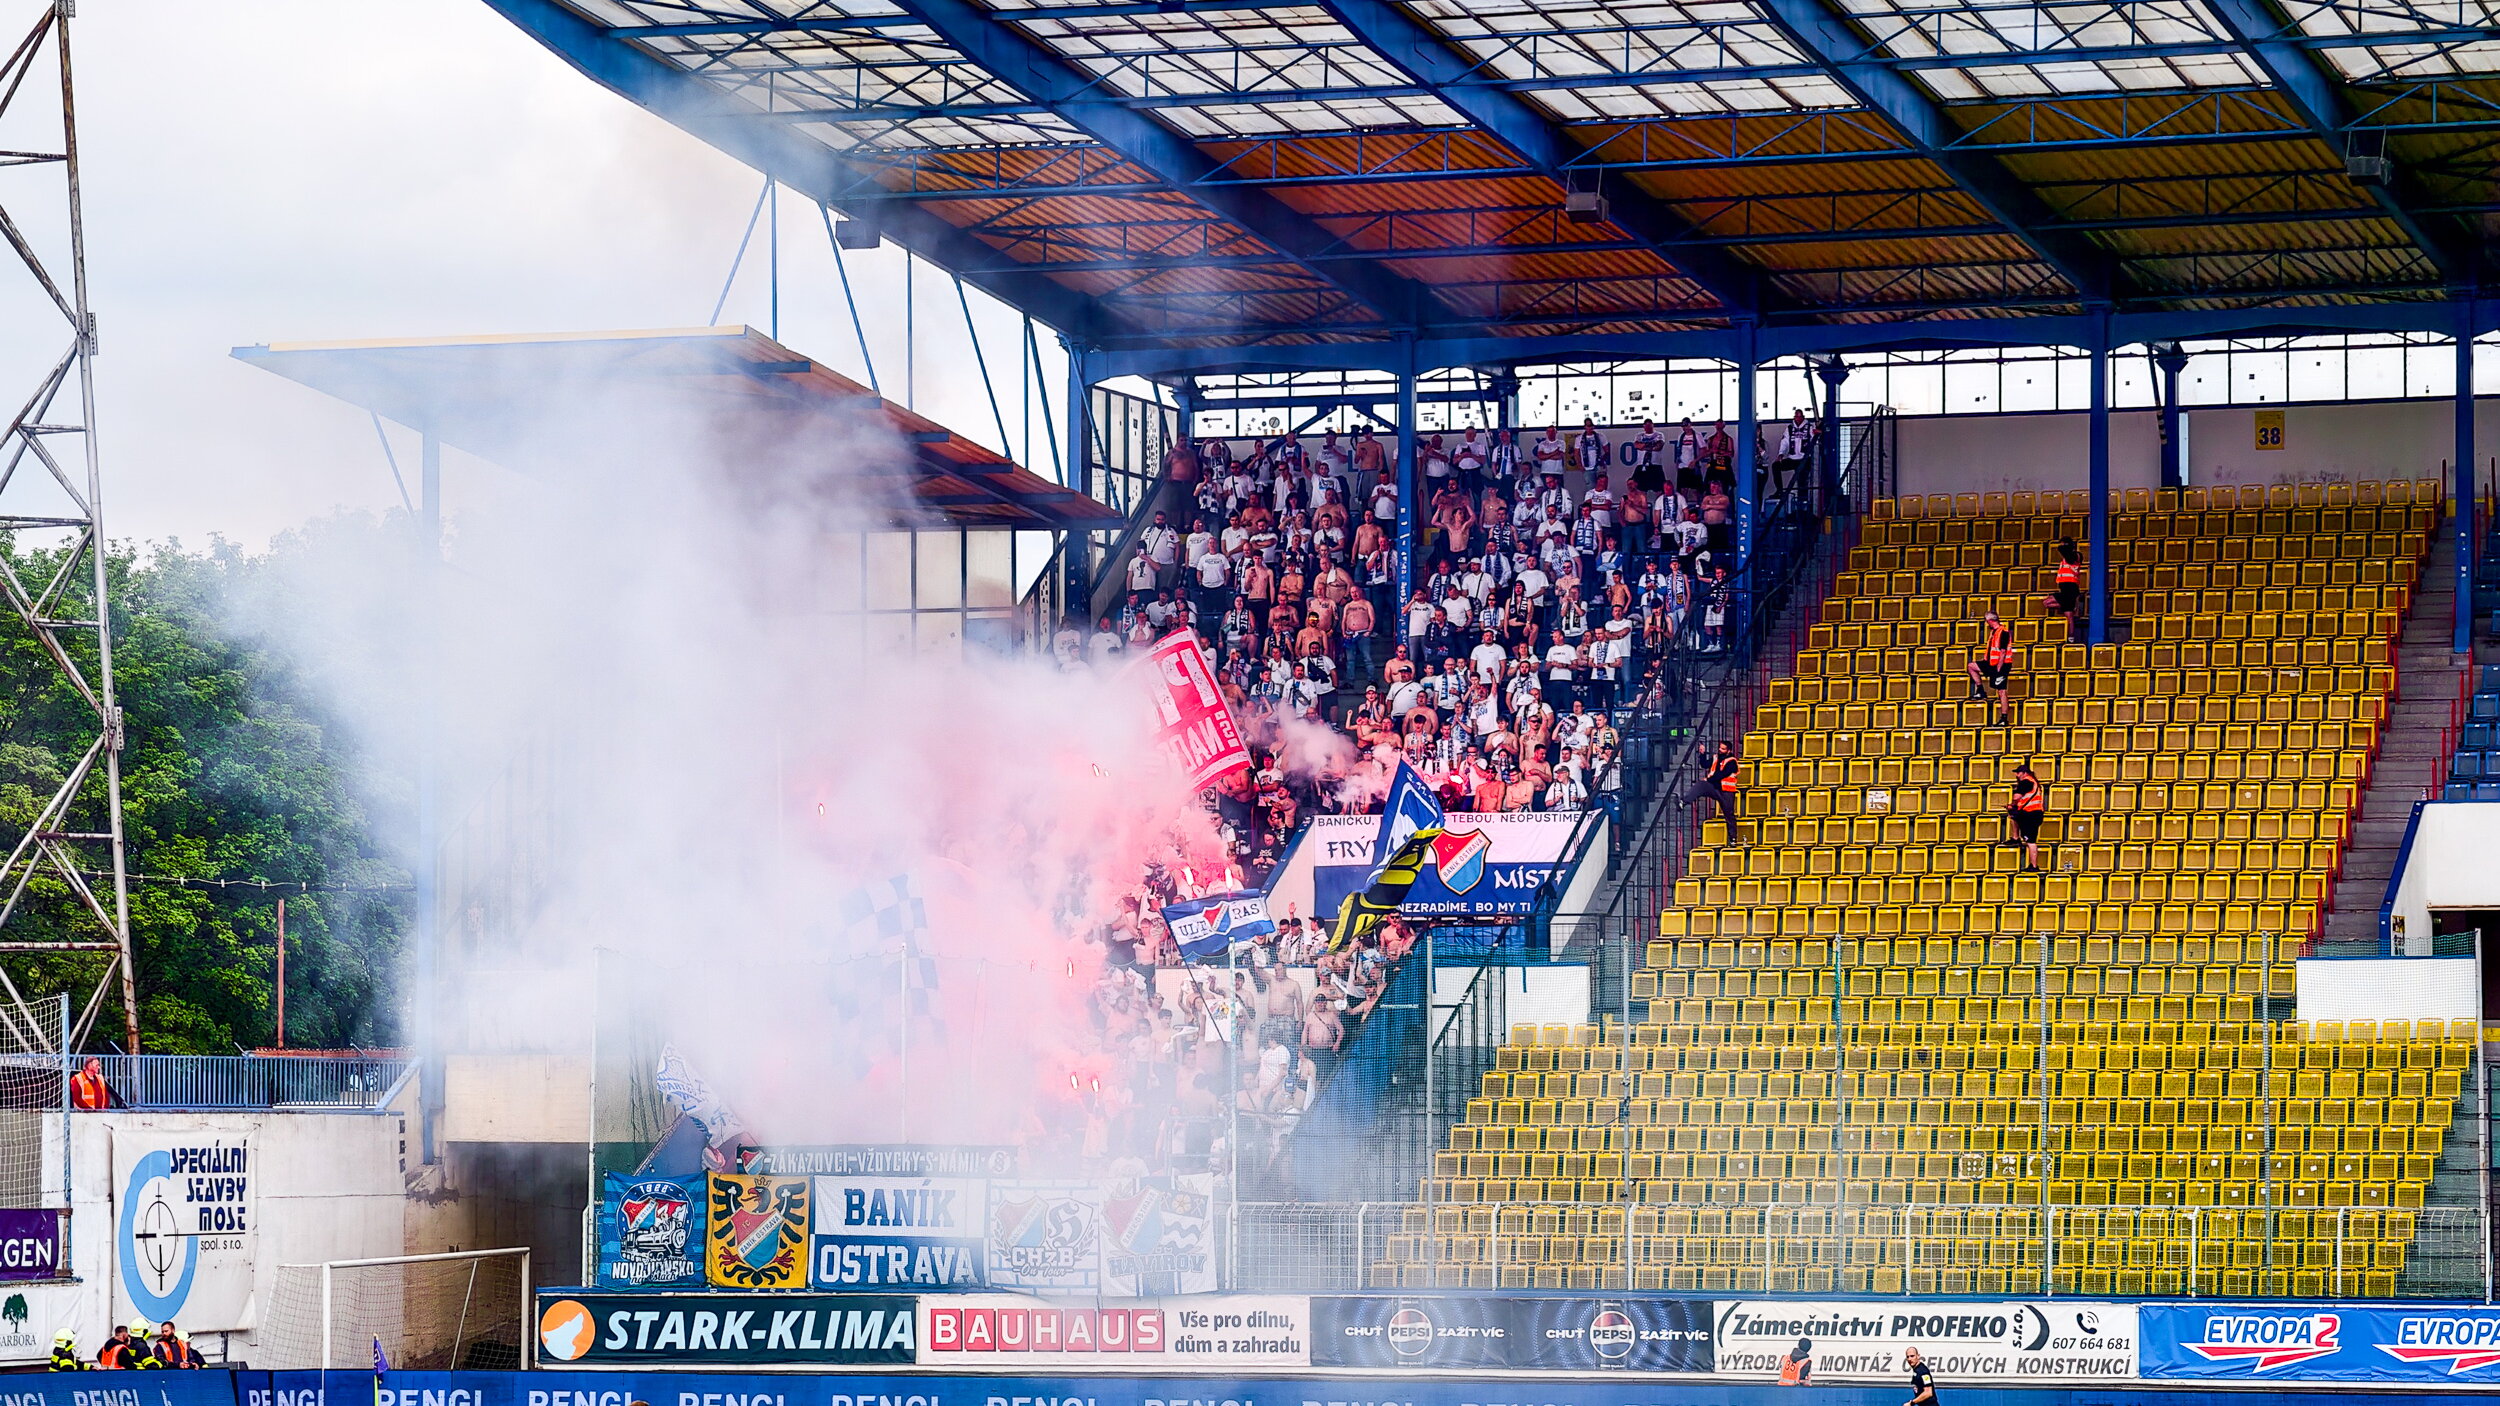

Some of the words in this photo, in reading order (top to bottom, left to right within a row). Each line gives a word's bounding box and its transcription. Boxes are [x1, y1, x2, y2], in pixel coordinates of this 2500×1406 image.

[2259, 427, 2281, 445] 38
[1327, 836, 1377, 858] FRÝ
[1459, 838, 1483, 862] OSTRAVA
[1475, 902, 1494, 912] BO
[1498, 902, 1516, 912] MY
[1520, 902, 1531, 912] TI
[171, 1139, 246, 1173] SPECIÁLNÍ
[187, 1177, 246, 1202] STAVBY
[844, 1179, 956, 1227] BANÍK
[199, 1206, 245, 1231] MOST
[755, 1215, 780, 1240] OSTRAVA
[0, 1239, 51, 1267] GEN
[200, 1238, 220, 1251] spol.
[223, 1241, 228, 1249] s
[819, 1244, 978, 1285] OSTRAVA
[605, 1310, 916, 1350] STARK-KLIMA
[934, 1312, 1160, 1345] BAUHAUS
[1180, 1311, 1208, 1328] Vše
[1213, 1316, 1242, 1332] pro
[1247, 1310, 1295, 1331] dílnu,
[1344, 1325, 1384, 1337] CHUŤ
[1390, 1327, 1430, 1338] PEPSI
[1437, 1326, 1479, 1338] ZAŽÍT
[1480, 1326, 1505, 1338] VÍC
[1731, 1313, 1883, 1337] Zámečnictví
[1890, 1315, 2007, 1338] PROFEKO
[2012, 1308, 2024, 1348] s.r.o.
[1175, 1335, 1212, 1353] dům
[1217, 1340, 1228, 1353] a
[1233, 1335, 1301, 1354] zahradu
[1545, 1327, 1586, 1340] CHUŤ
[1593, 1329, 1633, 1340] PEPSI
[1639, 1329, 1684, 1341] ZAŽÍT
[1685, 1330, 1709, 1341] VÍC
[2052, 1338, 2074, 1350] 607
[2079, 1338, 2103, 1350] 664
[2107, 1338, 2131, 1350] 681
[1784, 1359, 1796, 1372] 35
[1819, 1352, 1893, 1373] MONTÁŽ
[2016, 1355, 2132, 1375] KONSTRUKCÍ
